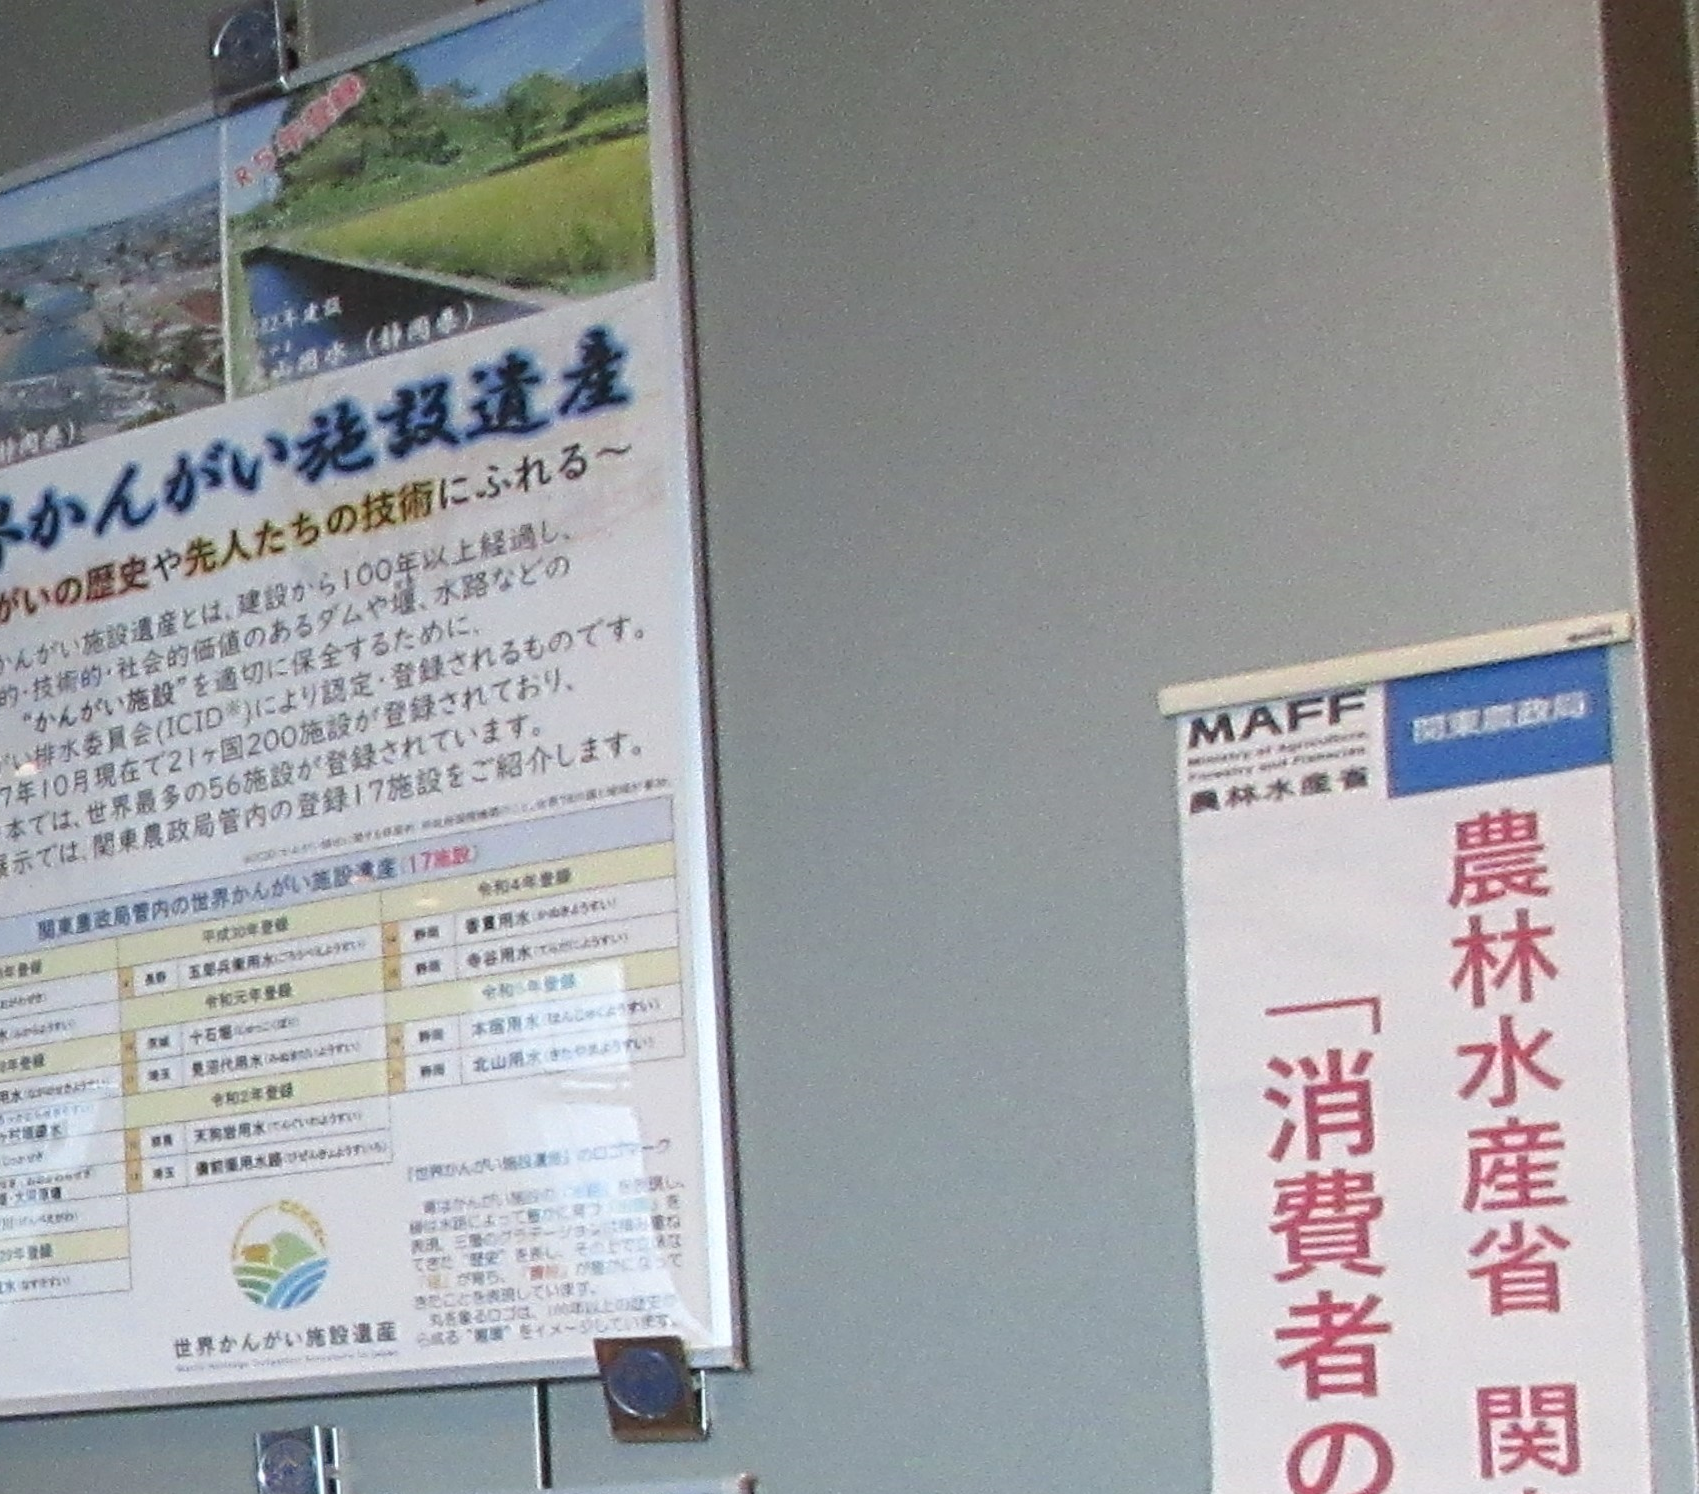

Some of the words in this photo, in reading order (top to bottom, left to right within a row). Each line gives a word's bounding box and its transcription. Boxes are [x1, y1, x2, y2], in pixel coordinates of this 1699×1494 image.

[1188, 687, 1367, 749] MAFF
[1189, 766, 1369, 815] 農林水産省
[1448, 808, 1571, 1316] 農林水産省
[173, 1321, 398, 1360] 世界かんがい施設遺産
